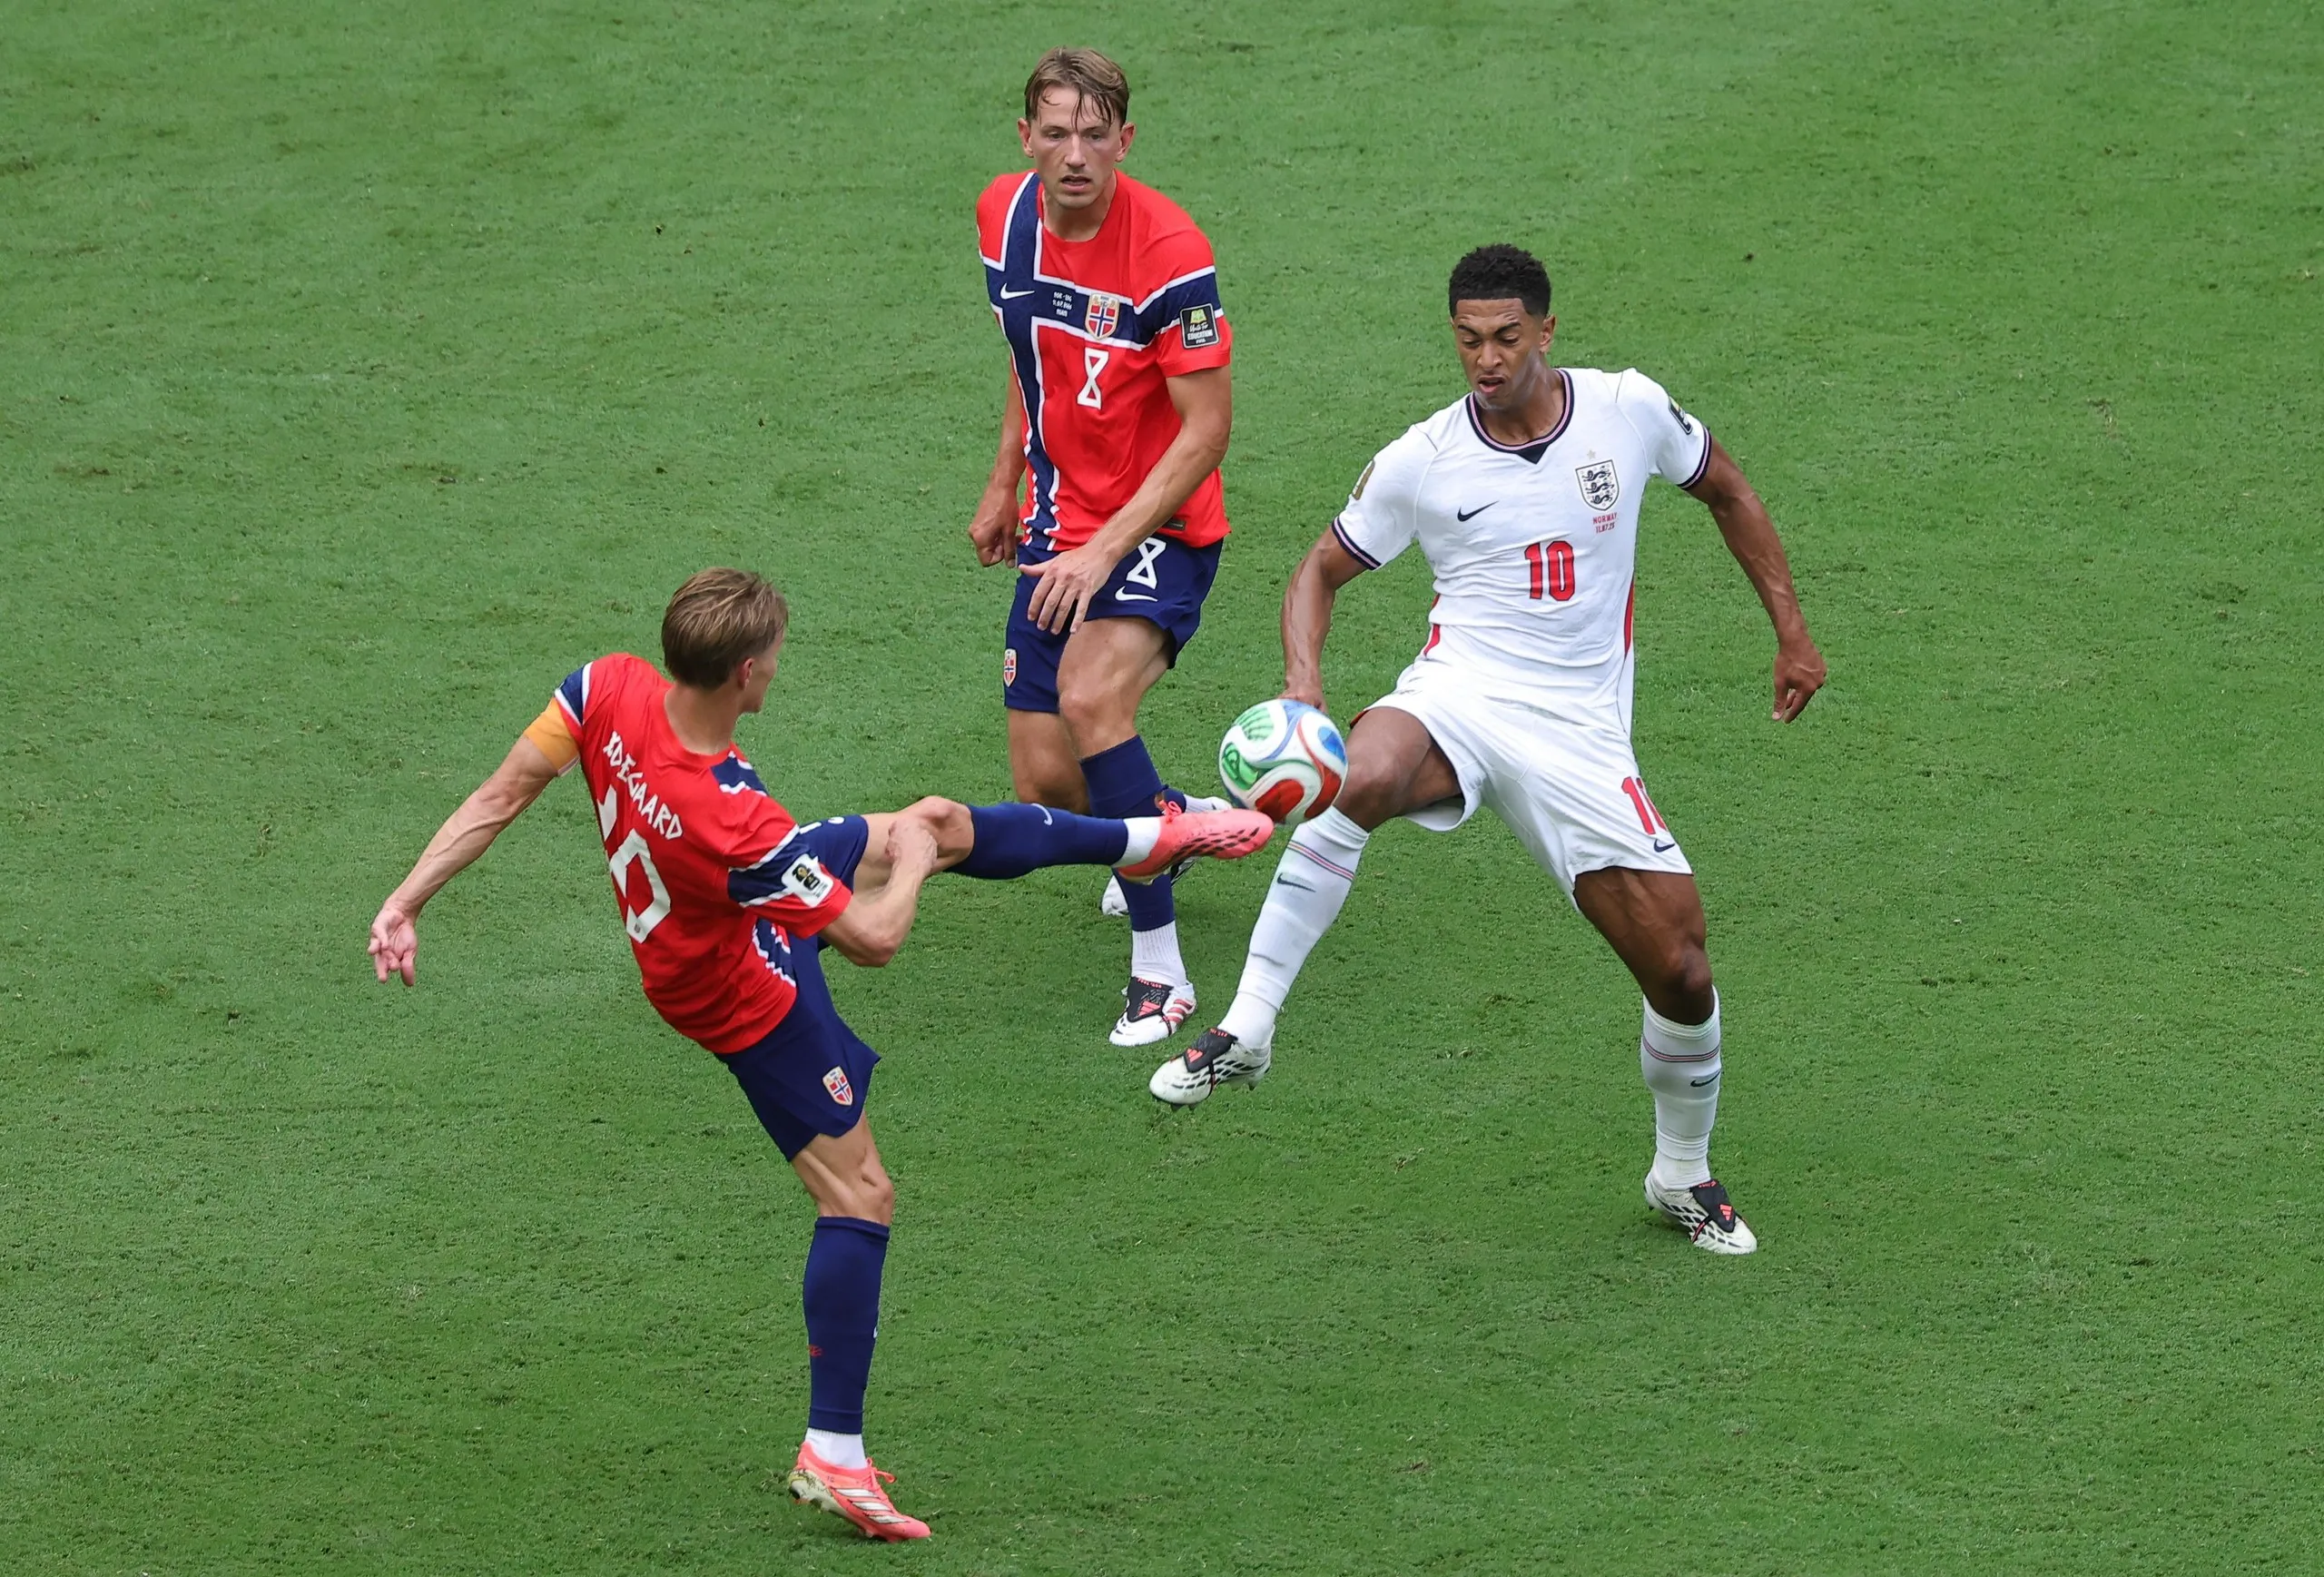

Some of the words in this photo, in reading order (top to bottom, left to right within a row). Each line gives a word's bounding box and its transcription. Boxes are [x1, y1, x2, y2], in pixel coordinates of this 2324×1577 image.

[1077, 348, 1109, 410] 8
[1592, 512, 1618, 525] NORWAY
[1126, 536, 1167, 590] 8
[1523, 539, 1576, 602] 10
